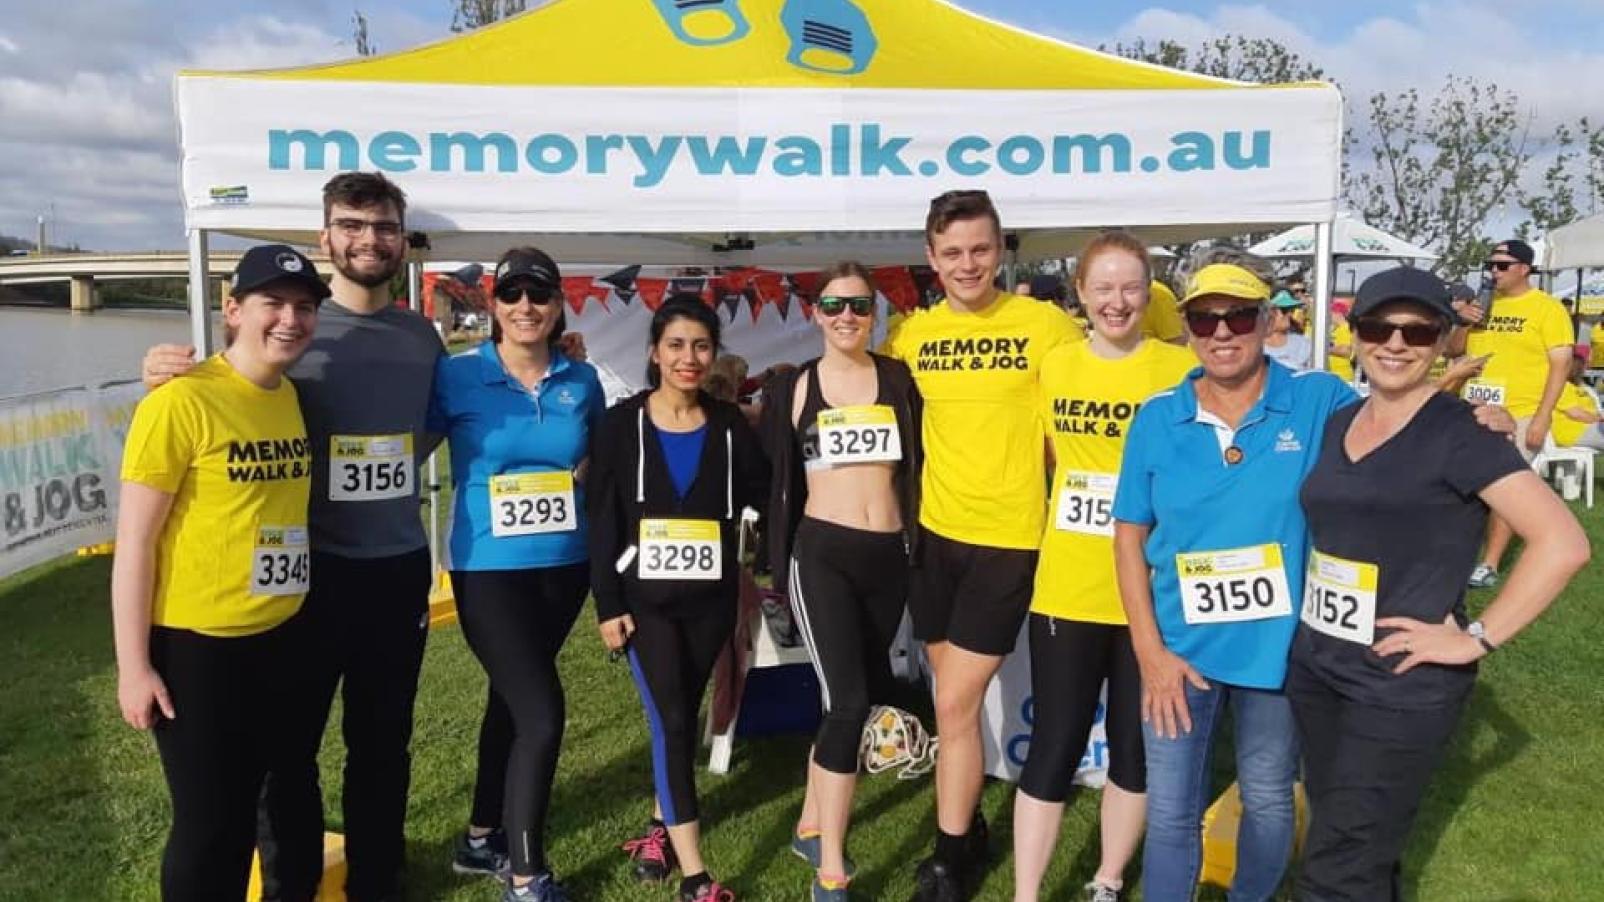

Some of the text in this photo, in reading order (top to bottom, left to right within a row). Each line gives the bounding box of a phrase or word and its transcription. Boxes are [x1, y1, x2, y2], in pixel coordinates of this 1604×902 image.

[268, 123, 1271, 188] memorywalk.com.au
[919, 338, 1029, 357] MEMORY
[918, 356, 1029, 371] WALK & JOG
[1054, 398, 1141, 420] MEMO
[829, 428, 890, 456] 3297
[1104, 422, 1121, 437] &
[227, 464, 287, 482] WALK
[291, 462, 303, 478] &
[342, 461, 406, 492] 3156
[5, 492, 26, 536] &
[32, 473, 107, 528] JOG
[500, 497, 567, 526] 3293
[647, 545, 714, 571] 3298
[1194, 577, 1274, 613] 3150
[1307, 583, 1358, 630] 3152
